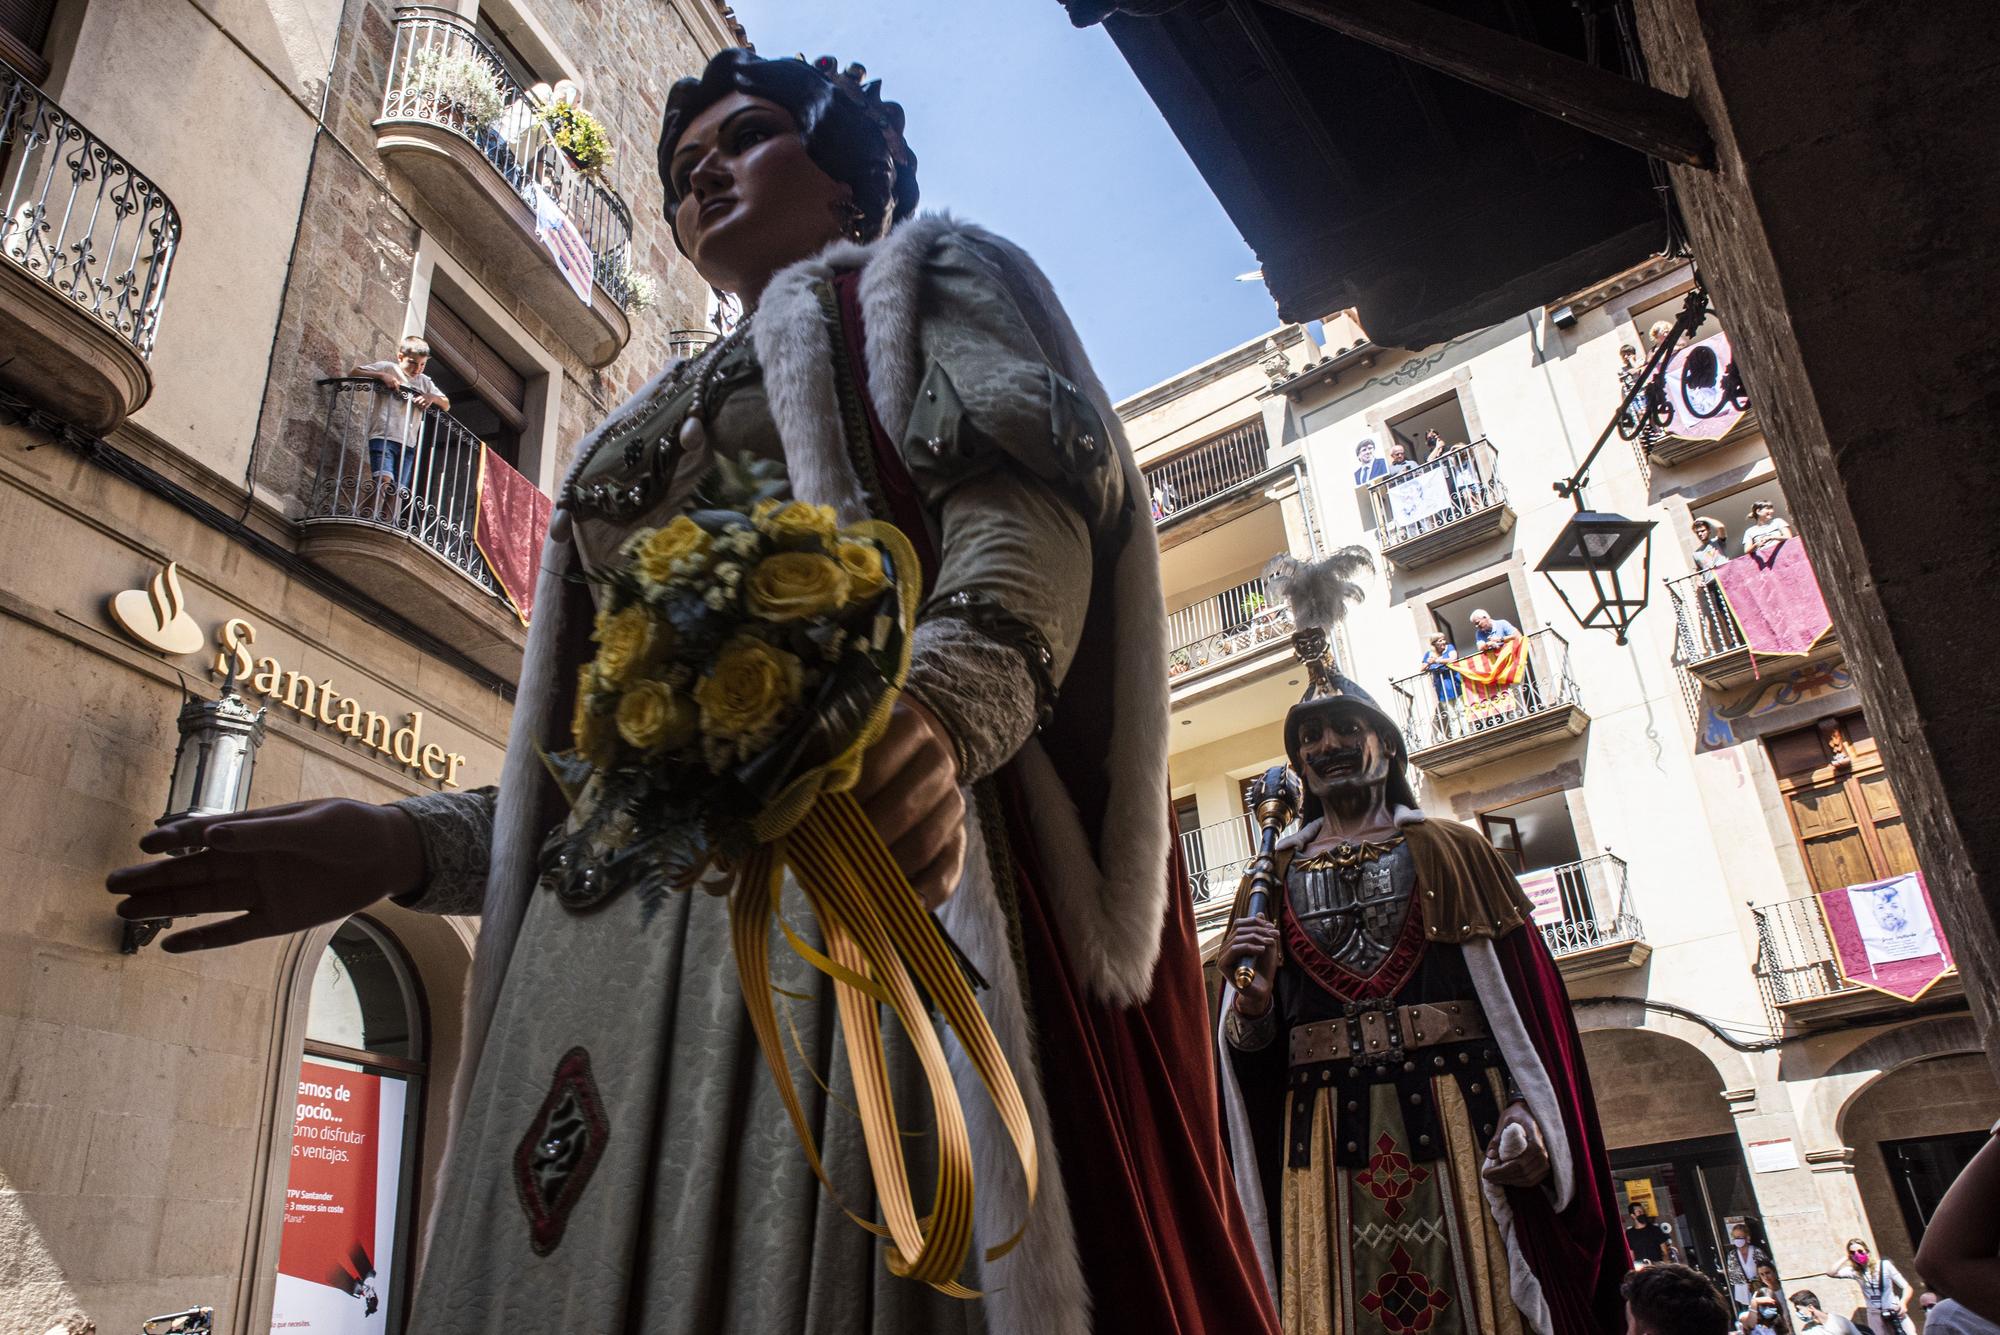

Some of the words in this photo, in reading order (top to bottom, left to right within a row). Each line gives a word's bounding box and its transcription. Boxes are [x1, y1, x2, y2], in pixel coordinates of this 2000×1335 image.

[212, 617, 466, 788] Santander
[334, 1084, 351, 1102] de
[320, 1126, 366, 1144] disfrutar
[302, 1145, 350, 1164] ventajas.
[287, 1189, 301, 1199] TPV
[301, 1190, 334, 1201] Santander
[290, 1202, 296, 1211] 3
[296, 1203, 317, 1212] meses
[317, 1203, 327, 1212] sin
[327, 1205, 344, 1214] coste
